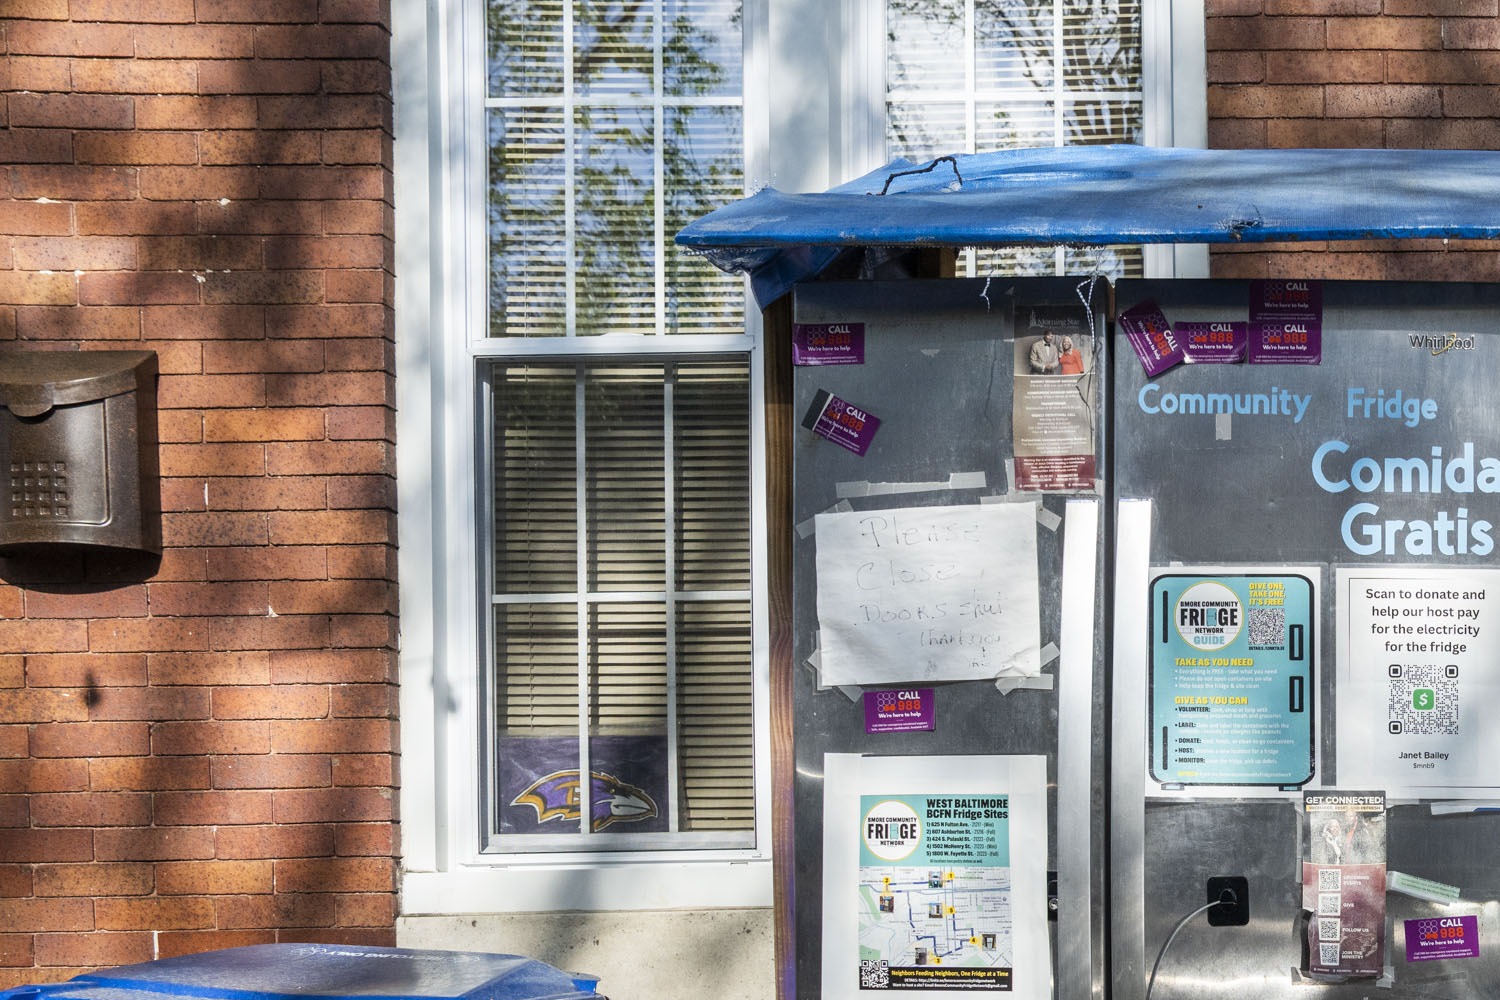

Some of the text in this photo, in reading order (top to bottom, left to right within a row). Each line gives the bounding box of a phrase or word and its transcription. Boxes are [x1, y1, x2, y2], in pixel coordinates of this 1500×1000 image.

[828, 325, 851, 333] CALL
[1210, 324, 1232, 332] CALL
[1284, 324, 1307, 332] CALL
[1163, 330, 1178, 352] CALL
[1284, 333, 1307, 343] 988
[1408, 334, 1475, 352] Whirlpool
[1154, 334, 1172, 356] 988
[1138, 384, 1437, 428] Community Fridge
[846, 406, 866, 422] CALL
[1340, 503, 1494, 556] Gratis
[1366, 588, 1486, 600] Scan to donate and
[1180, 608, 1238, 626] FRIGE
[1372, 606, 1480, 620] help our host pay
[1372, 624, 1480, 637] for the electricity
[1193, 636, 1225, 645] GUIDE
[1385, 641, 1466, 654] for the fridge
[1175, 658, 1253, 666] TAKE AS YOU NEED
[898, 691, 920, 700] CALL
[1175, 696, 1248, 705] GIVE AS YOU CAN
[898, 700, 920, 710] 988
[1424, 751, 1449, 760] Bailey
[927, 798, 1008, 808] WEST BALTIMORE
[927, 809, 1008, 820] BCFN Fridge Sites
[868, 824, 916, 839] FRIGE
[1440, 919, 1463, 927] CALL
[1440, 927, 1464, 938] 988
